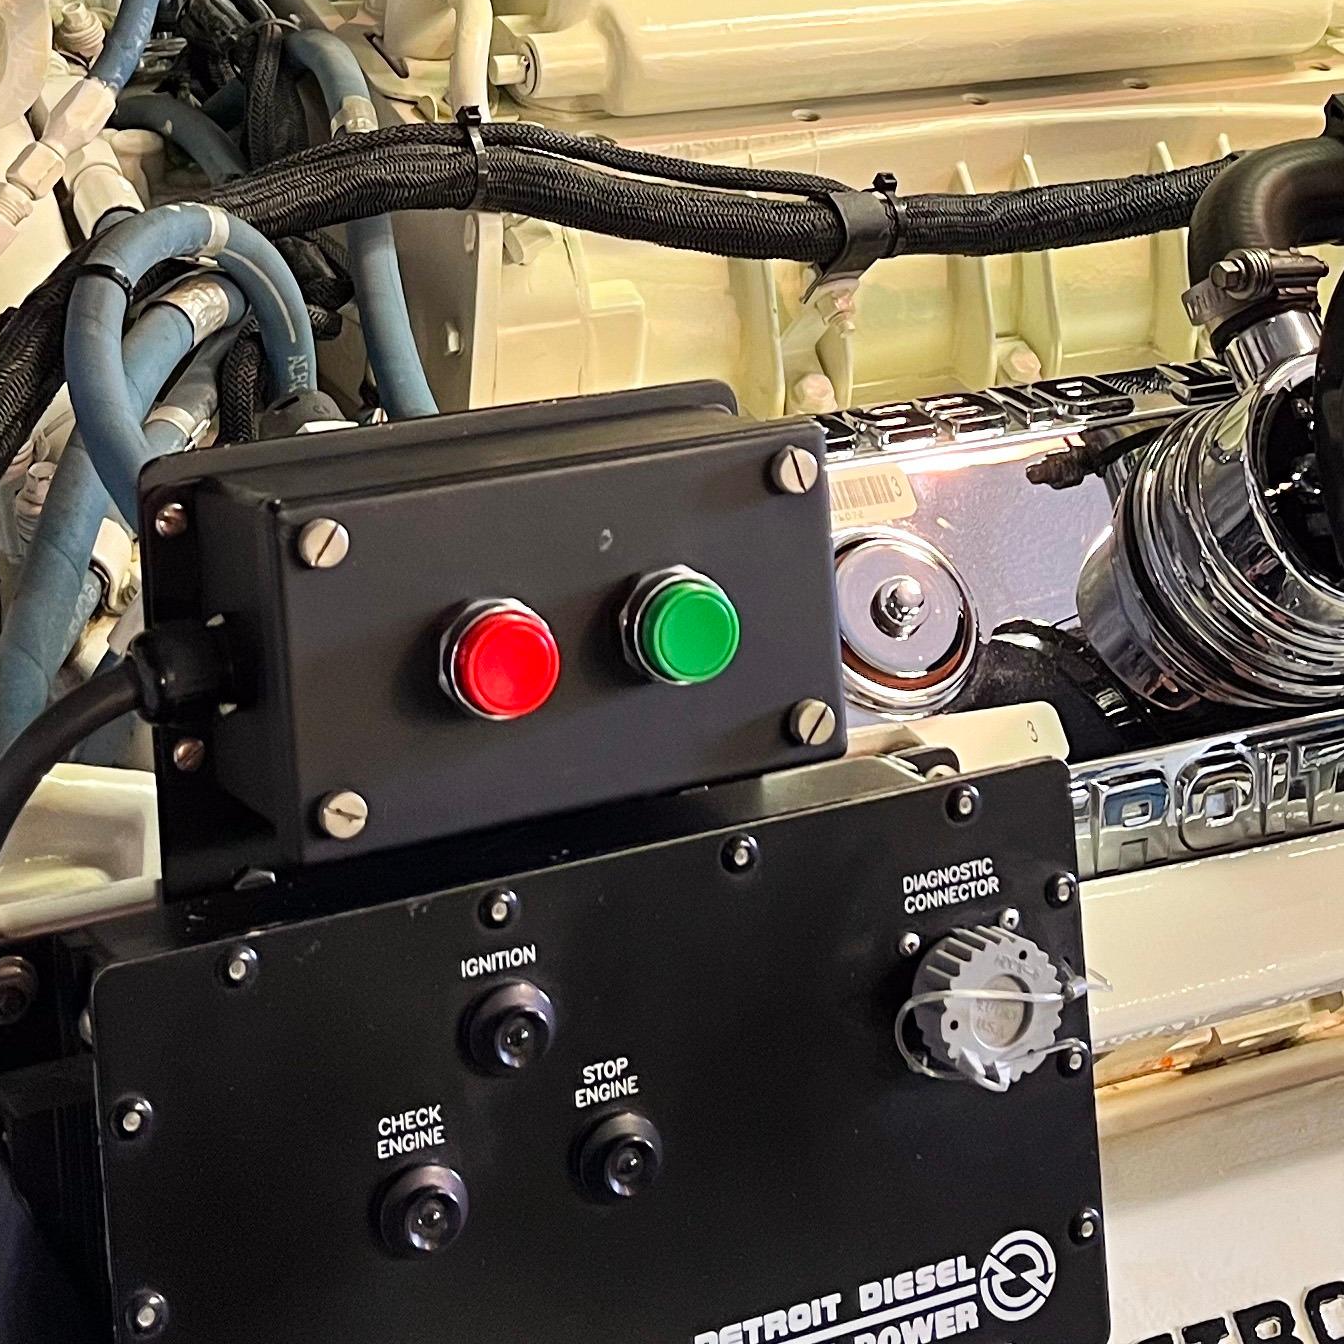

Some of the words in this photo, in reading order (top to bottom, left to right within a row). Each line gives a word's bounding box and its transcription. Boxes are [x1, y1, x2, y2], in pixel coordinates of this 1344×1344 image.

[902, 856, 994, 895] DIAGNOSTIC
[903, 875, 1000, 915] CONNECTOR
[460, 943, 537, 978] IGNITION
[582, 1056, 629, 1085] STOP
[574, 1074, 640, 1109] ENGINE
[377, 1103, 443, 1137] CHECK
[376, 1124, 447, 1160] ENGINE
[858, 1254, 978, 1314] DIESEL
